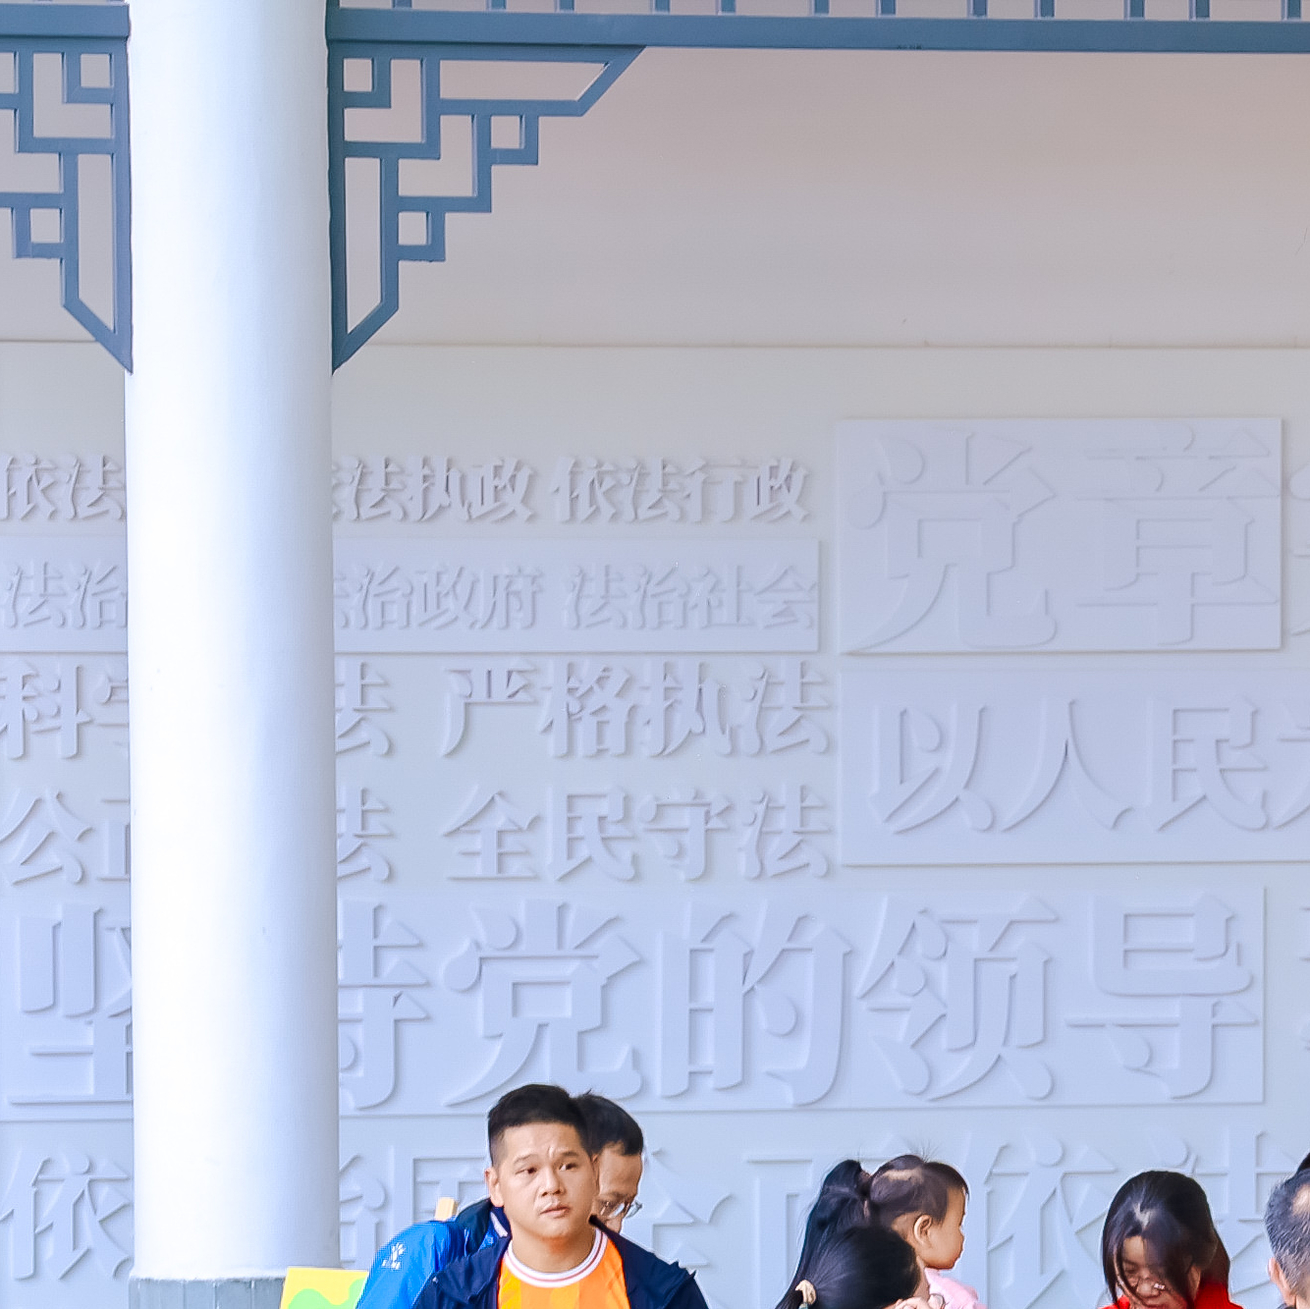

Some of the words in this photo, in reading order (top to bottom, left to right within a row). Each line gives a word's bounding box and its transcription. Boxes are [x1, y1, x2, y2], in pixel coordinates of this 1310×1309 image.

[332, 454, 536, 523] 法执政
[549, 455, 810, 524] 依法行政
[847, 426, 1279, 653] 党章
[333, 561, 545, 631] 治政府
[561, 561, 816, 631] 法治社会
[441, 659, 831, 759] 严格执法
[441, 785, 832, 884] 全民守法
